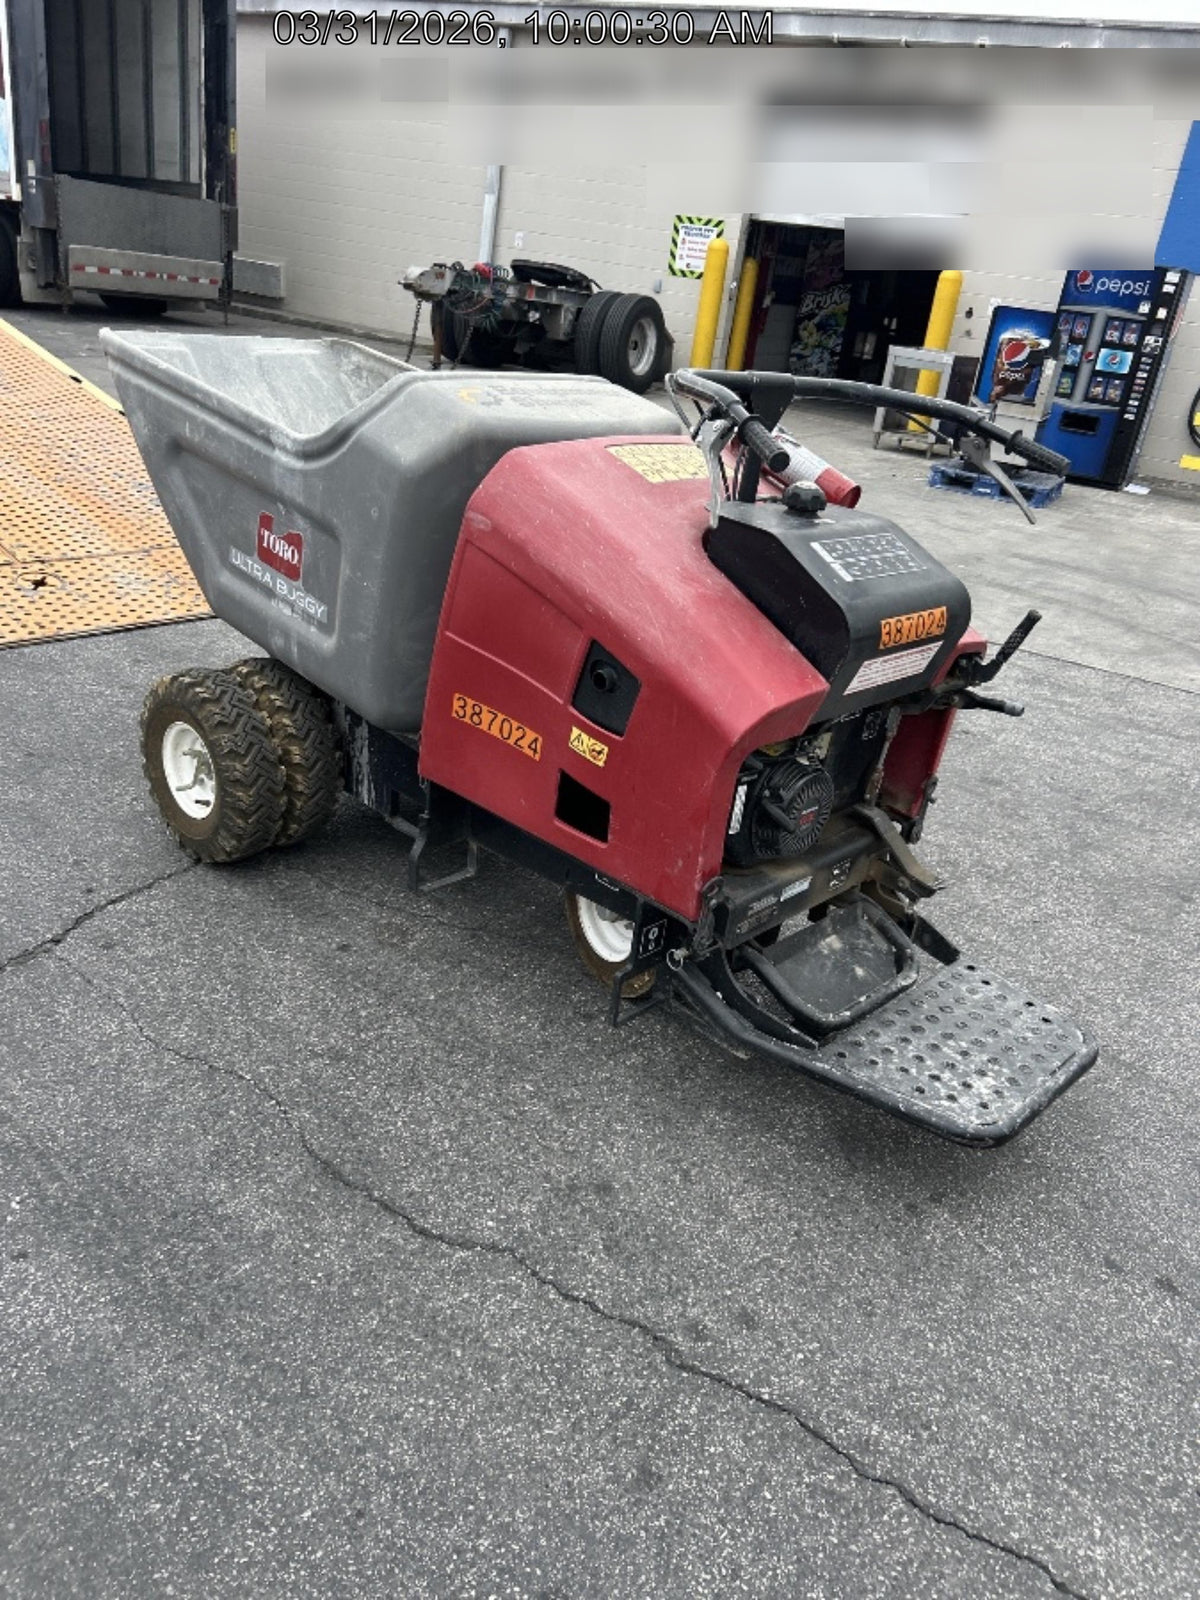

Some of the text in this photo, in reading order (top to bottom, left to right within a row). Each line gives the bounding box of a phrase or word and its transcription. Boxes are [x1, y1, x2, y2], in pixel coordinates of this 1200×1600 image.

[1095, 277, 1151, 296] pepsi
[261, 528, 299, 565] TORO
[229, 546, 273, 587] ULTRA
[276, 578, 325, 618] BUGGY
[882, 610, 945, 647] 387024
[454, 696, 539, 757] 387024
